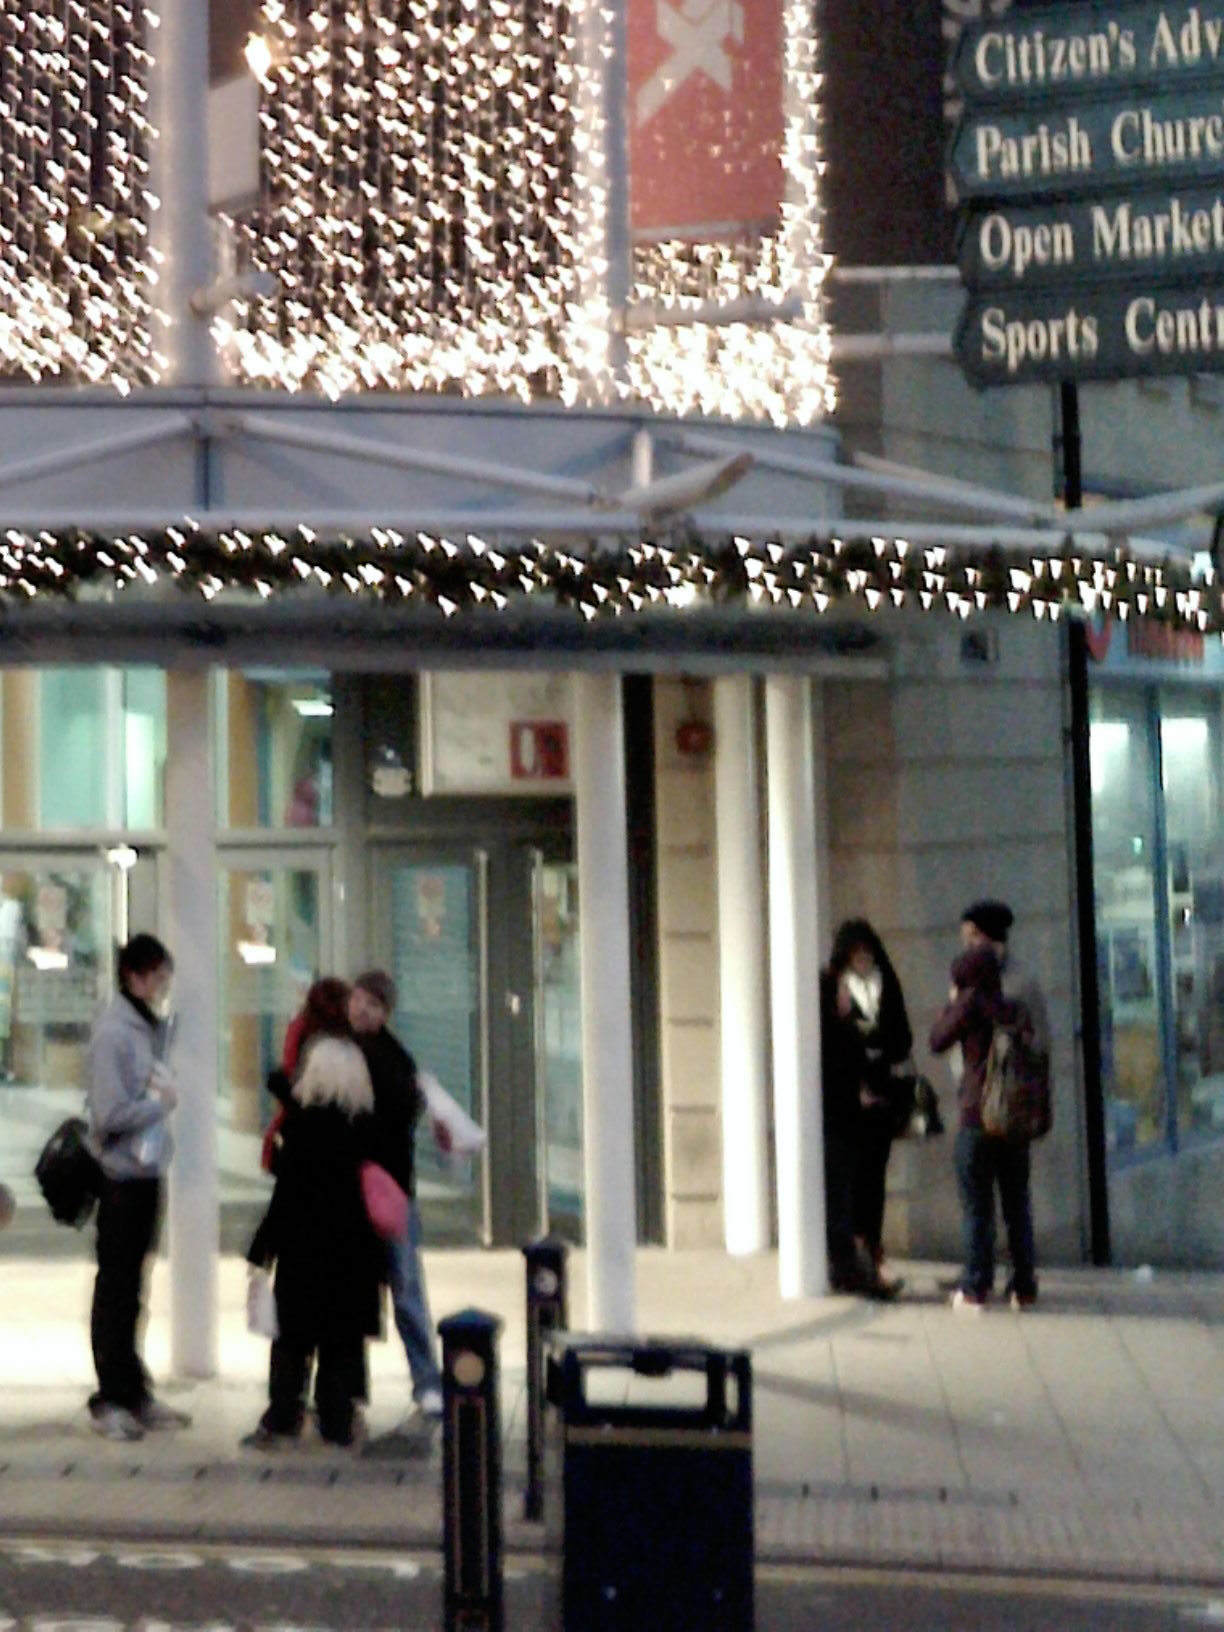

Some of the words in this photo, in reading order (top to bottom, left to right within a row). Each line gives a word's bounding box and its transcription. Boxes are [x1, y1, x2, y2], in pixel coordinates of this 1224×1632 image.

[976, 21, 1137, 88] Citizen's
[976, 118, 1092, 180] Parish
[980, 214, 1074, 278] Open
[1091, 199, 1223, 261] Market
[982, 307, 1099, 373] Sports
